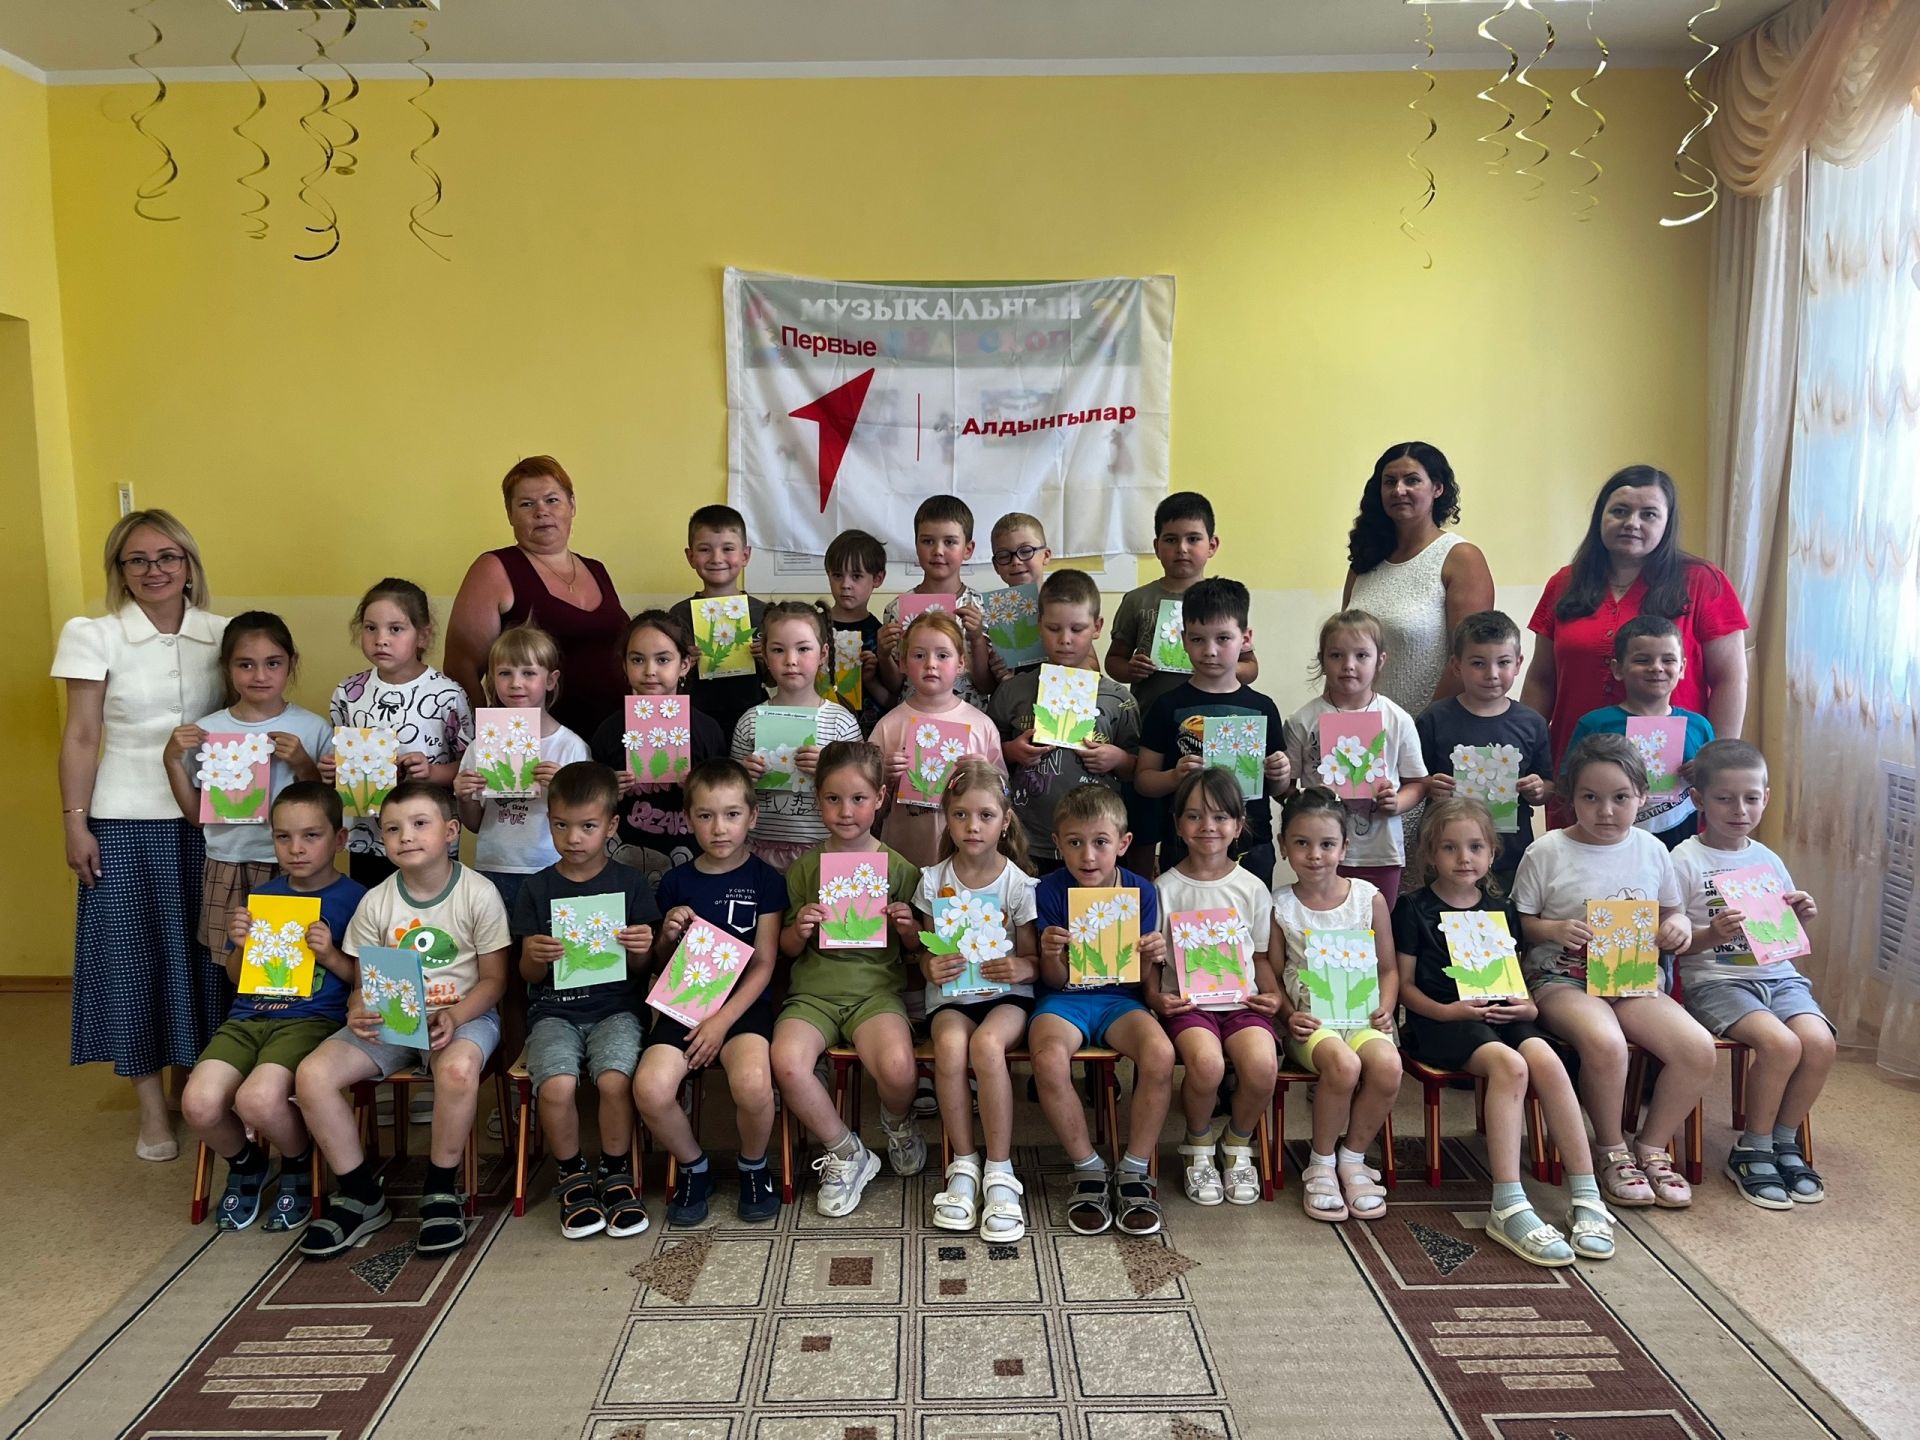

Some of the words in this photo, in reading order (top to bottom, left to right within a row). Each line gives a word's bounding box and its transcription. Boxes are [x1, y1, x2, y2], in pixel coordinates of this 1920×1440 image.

[799, 295, 1082, 322] МУЗЫКАЛЬНЫЙ
[781, 324, 878, 357] Первые
[961, 405, 1136, 437] Алдынгылар
